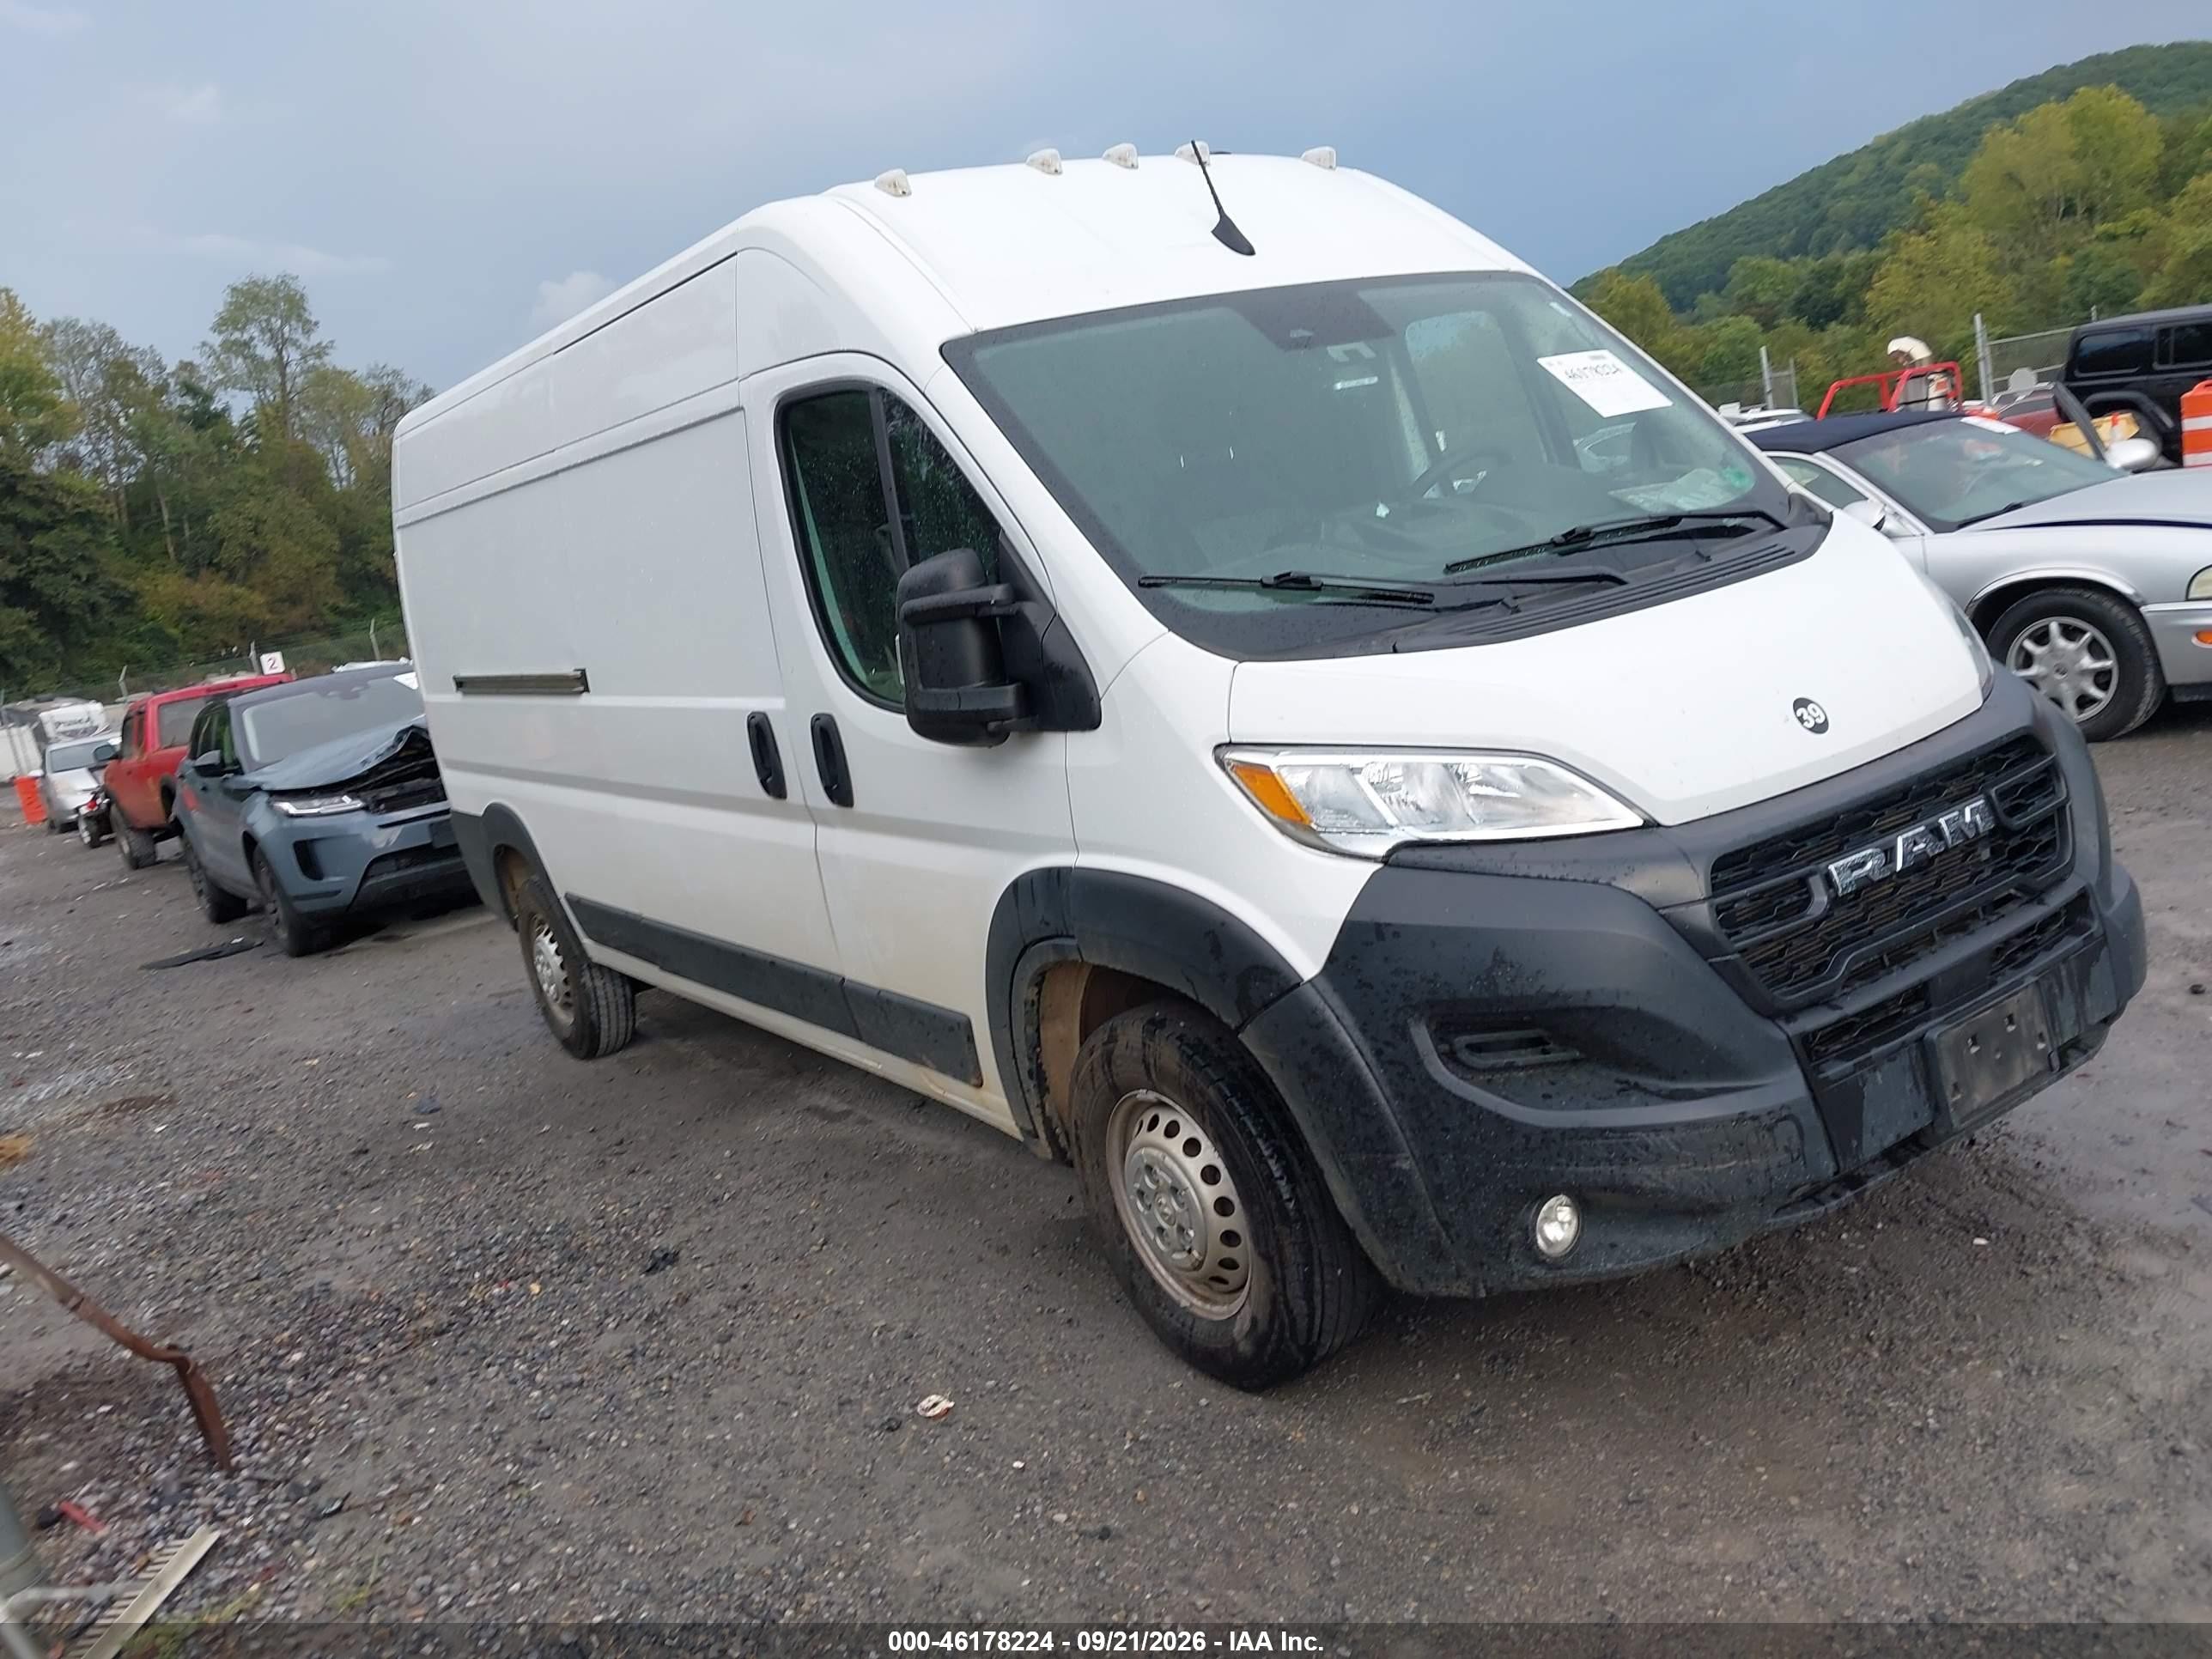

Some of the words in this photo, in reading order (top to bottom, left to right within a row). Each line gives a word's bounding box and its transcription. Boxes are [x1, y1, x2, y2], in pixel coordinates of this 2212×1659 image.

[267, 656, 278, 671] 2
[1796, 702, 1826, 729] 39
[1828, 798, 1996, 897] RAM
